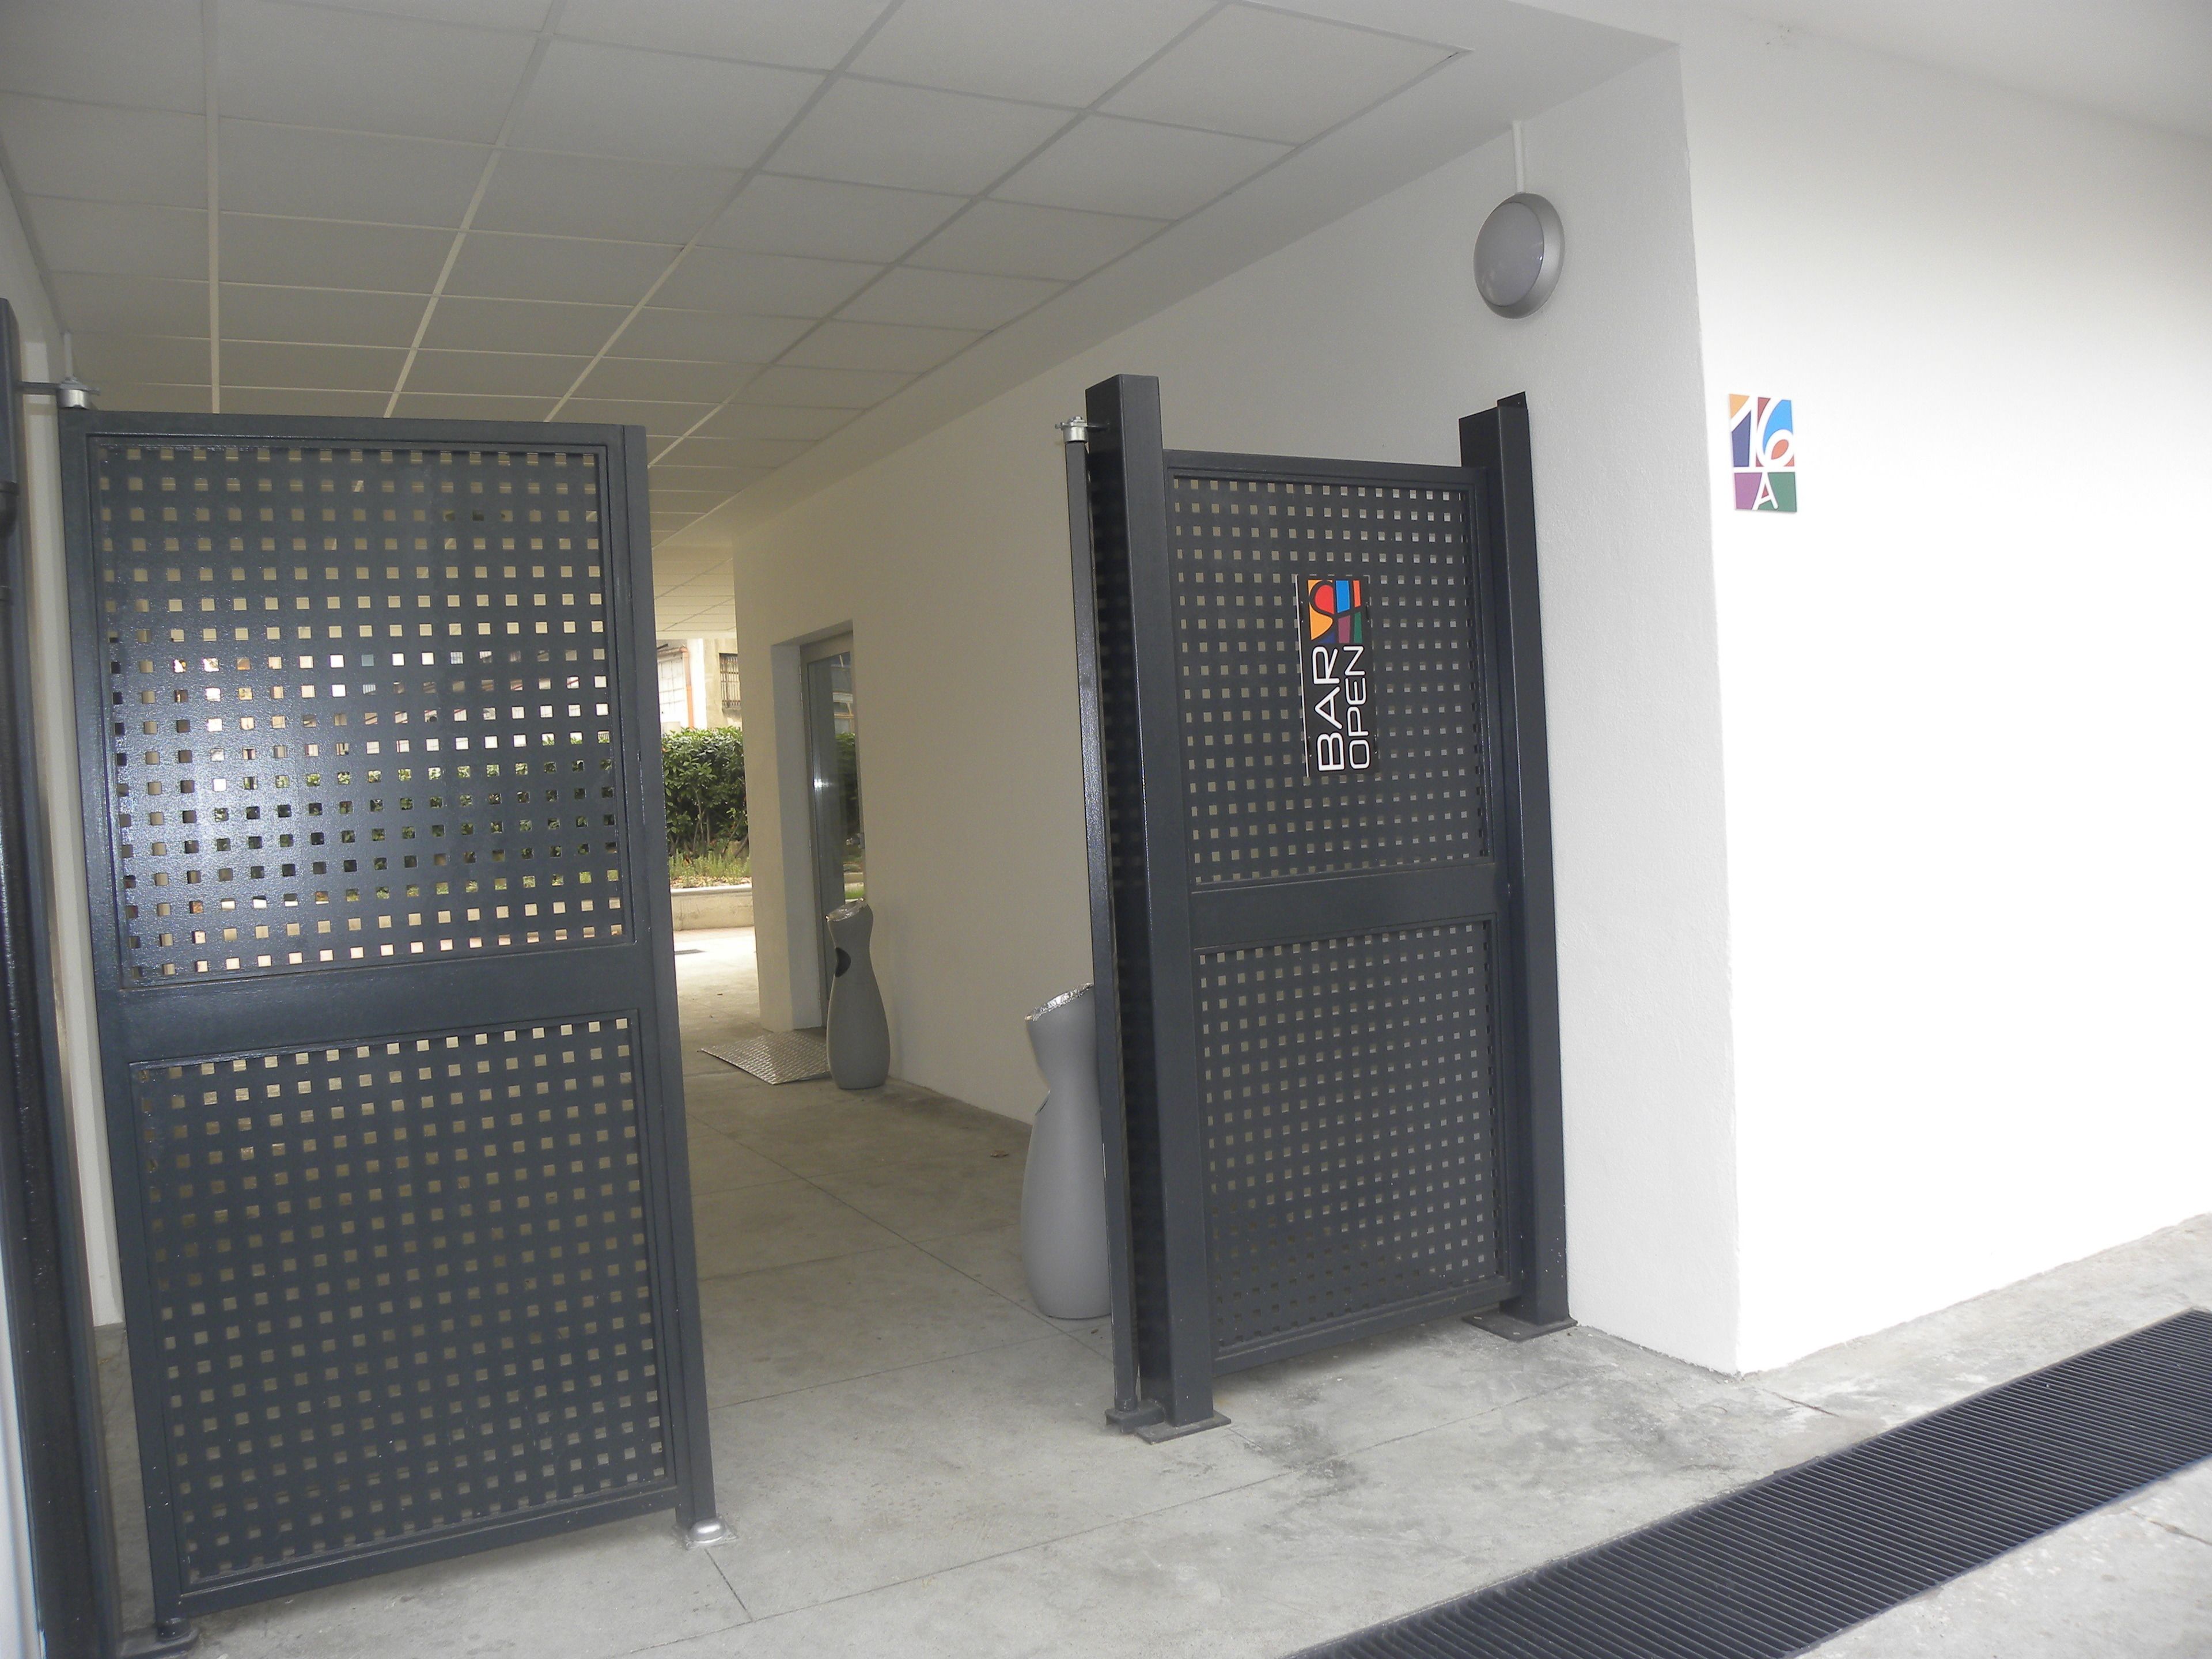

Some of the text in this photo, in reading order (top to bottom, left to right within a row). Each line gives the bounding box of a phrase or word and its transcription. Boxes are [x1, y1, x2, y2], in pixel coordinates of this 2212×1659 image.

[1730, 395, 1794, 467] 16
[1752, 471, 1779, 510] A
[1312, 646, 1344, 771] BAR
[1343, 646, 1370, 770] OPEN
